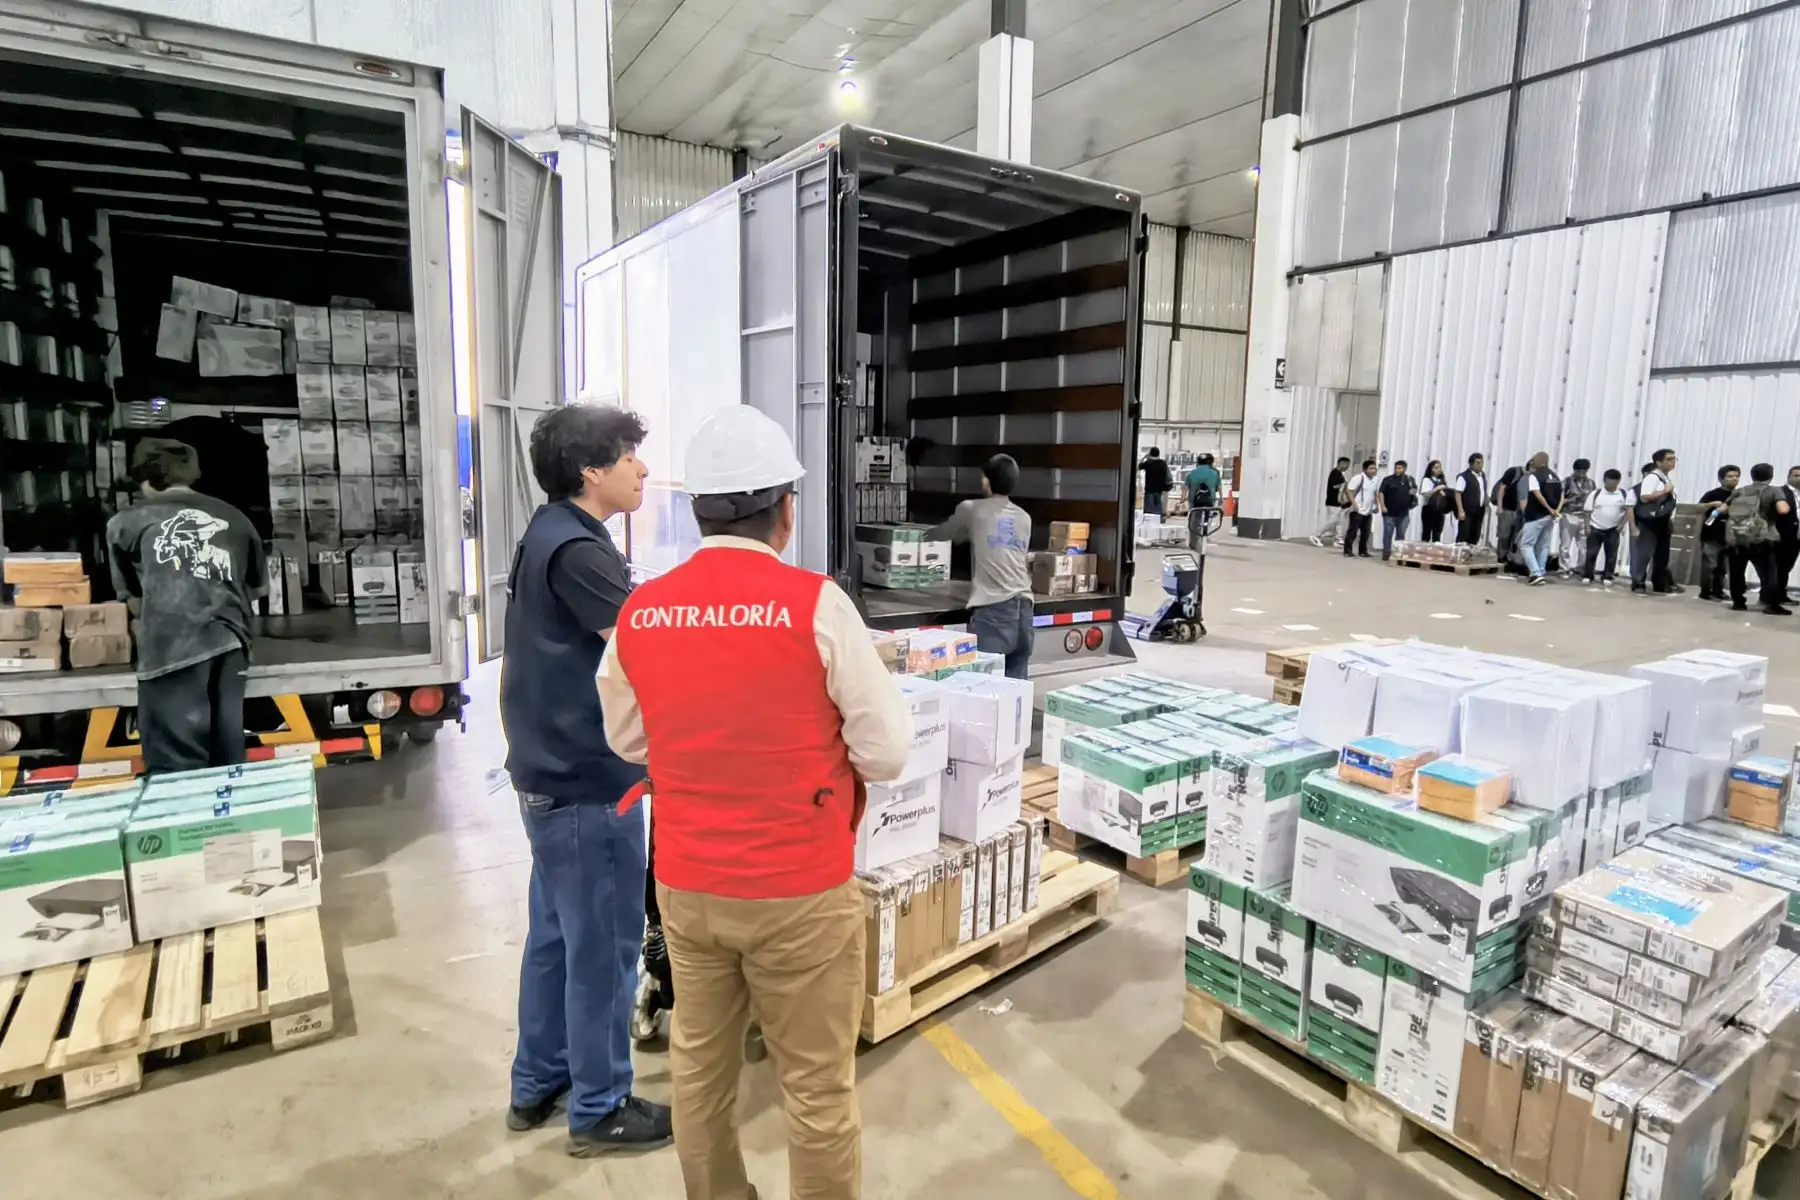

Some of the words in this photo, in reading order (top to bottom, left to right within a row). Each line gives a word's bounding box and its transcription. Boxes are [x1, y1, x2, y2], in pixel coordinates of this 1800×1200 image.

[631, 600, 792, 630] CONTRALORÍA
[889, 804, 937, 824] Powerplus
[137, 834, 163, 856] hp
